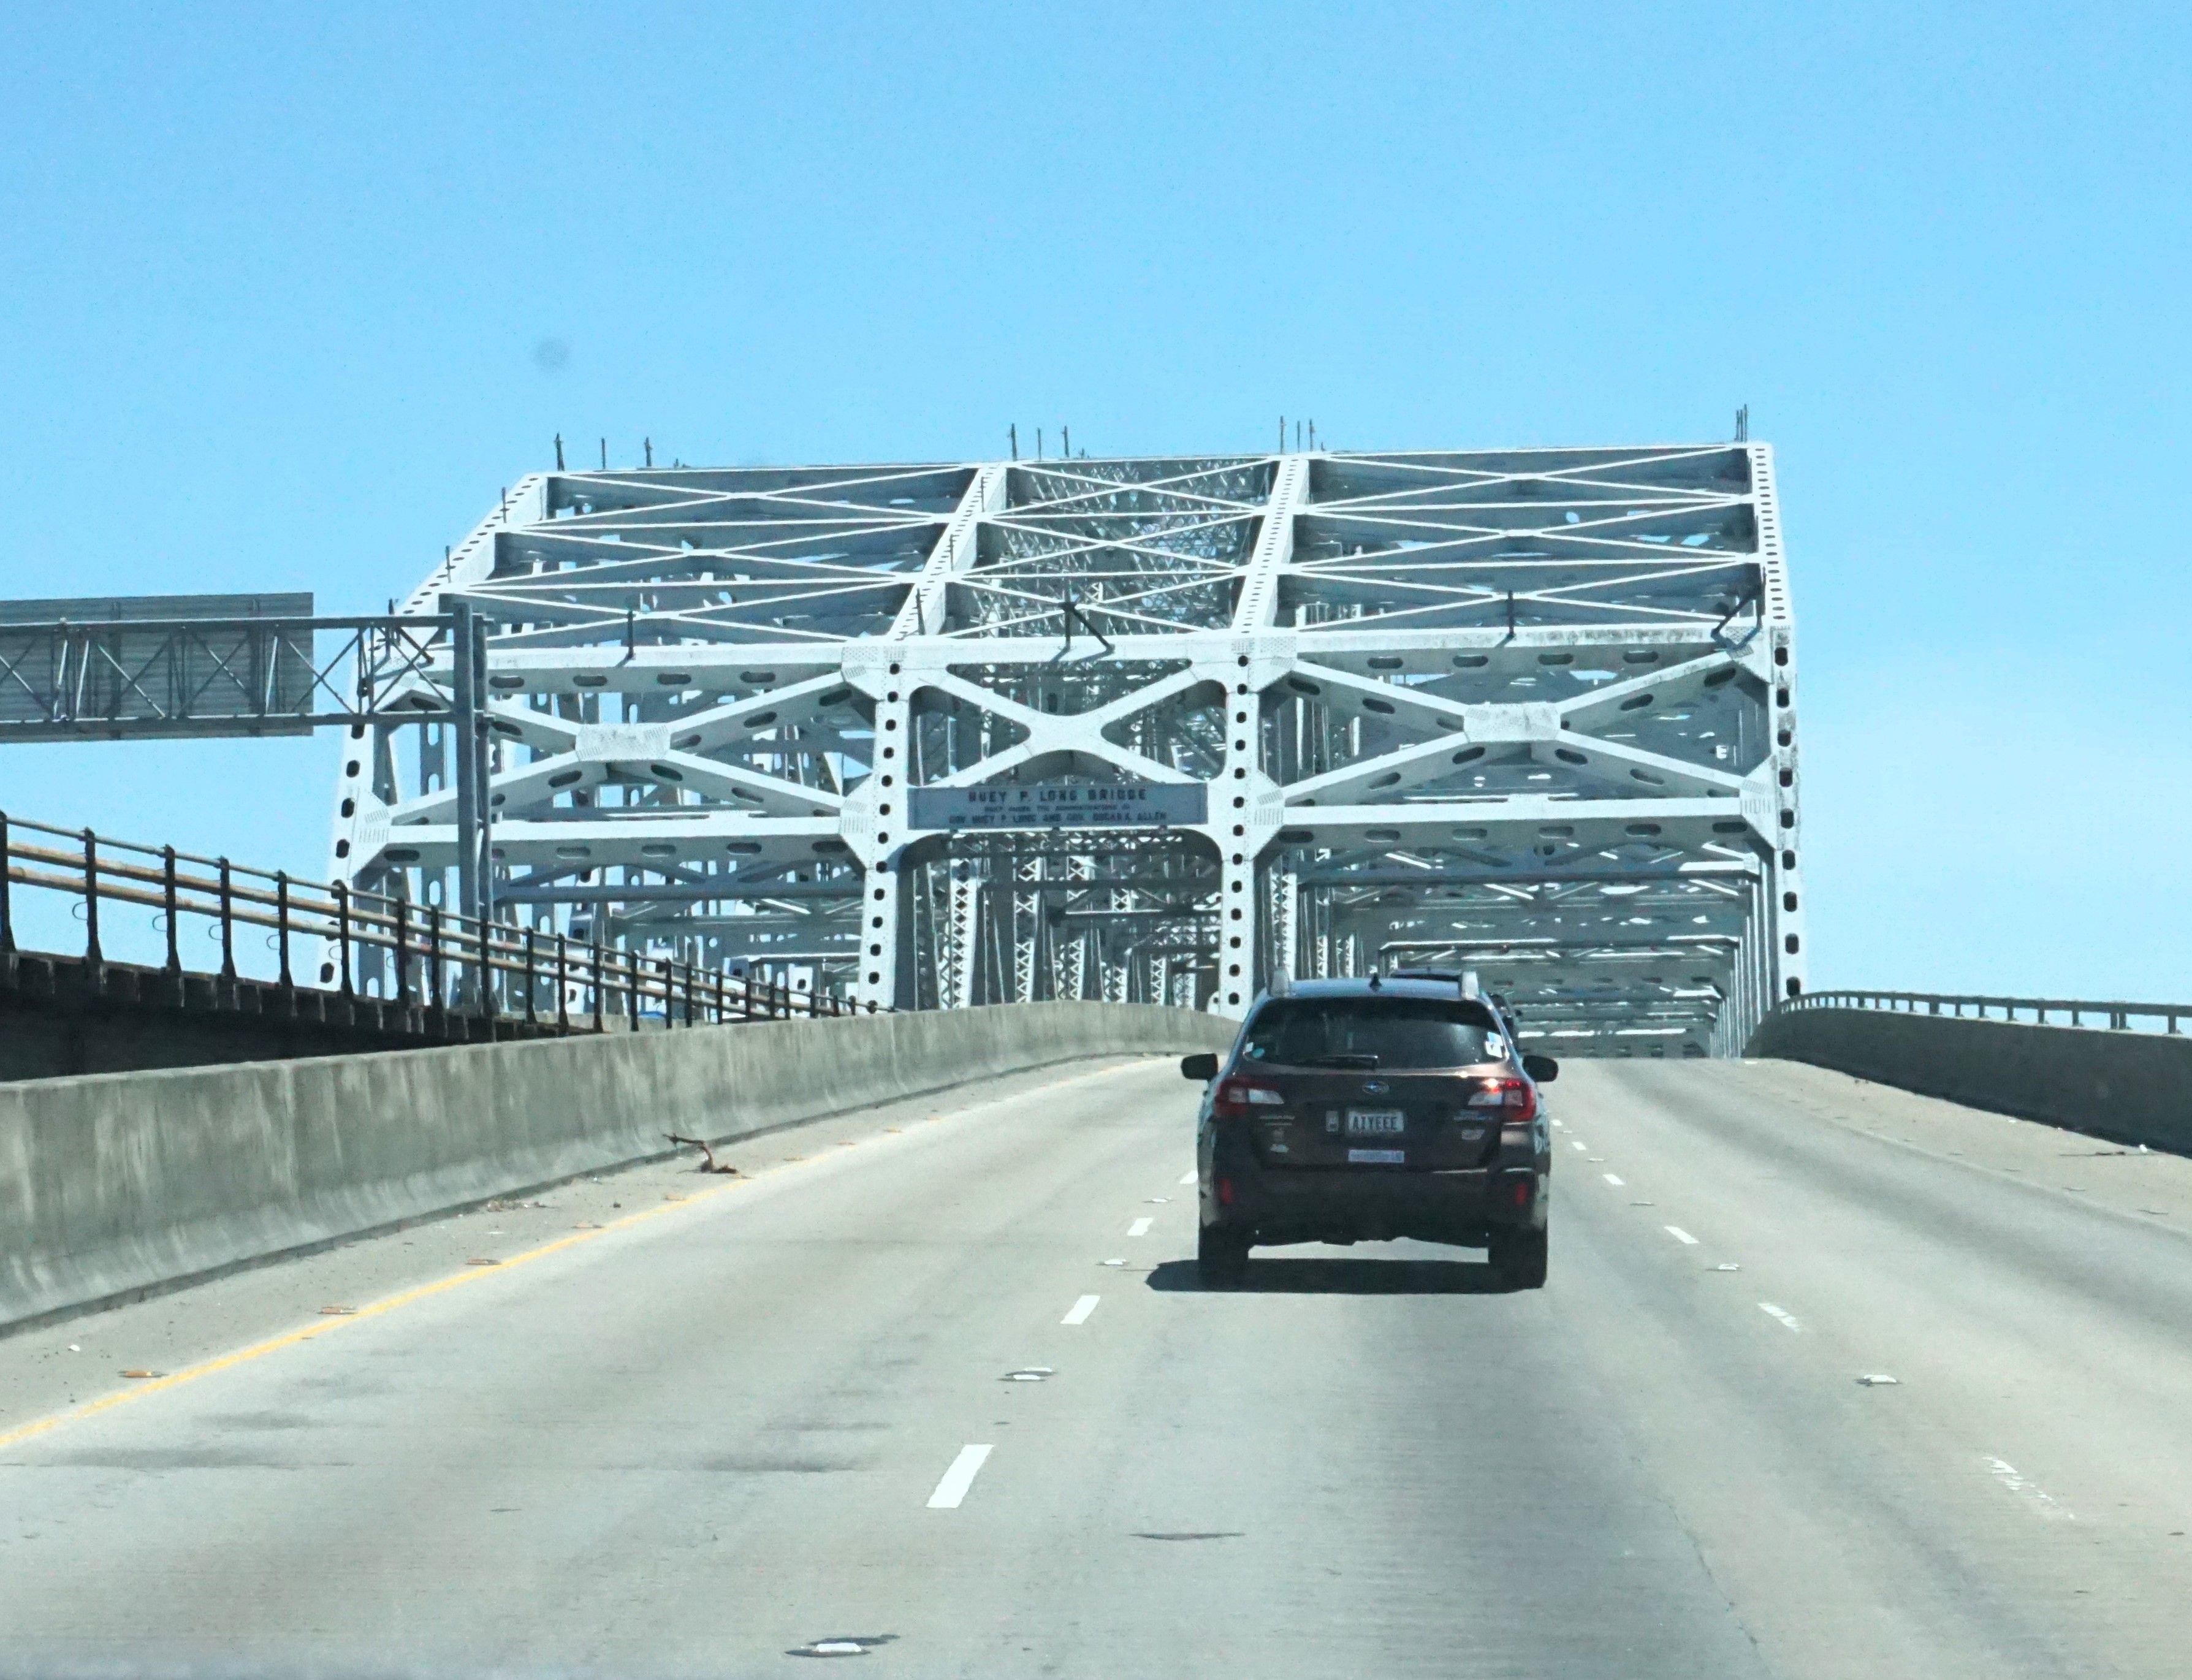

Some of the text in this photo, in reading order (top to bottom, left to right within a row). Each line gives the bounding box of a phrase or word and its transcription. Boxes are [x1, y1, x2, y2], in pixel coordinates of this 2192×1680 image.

[969, 791, 1007, 802] HUEY
[1040, 790, 1077, 802] LONG
[1087, 789, 1146, 800] BRIDGE
[1137, 811, 1168, 821] ALLEN
